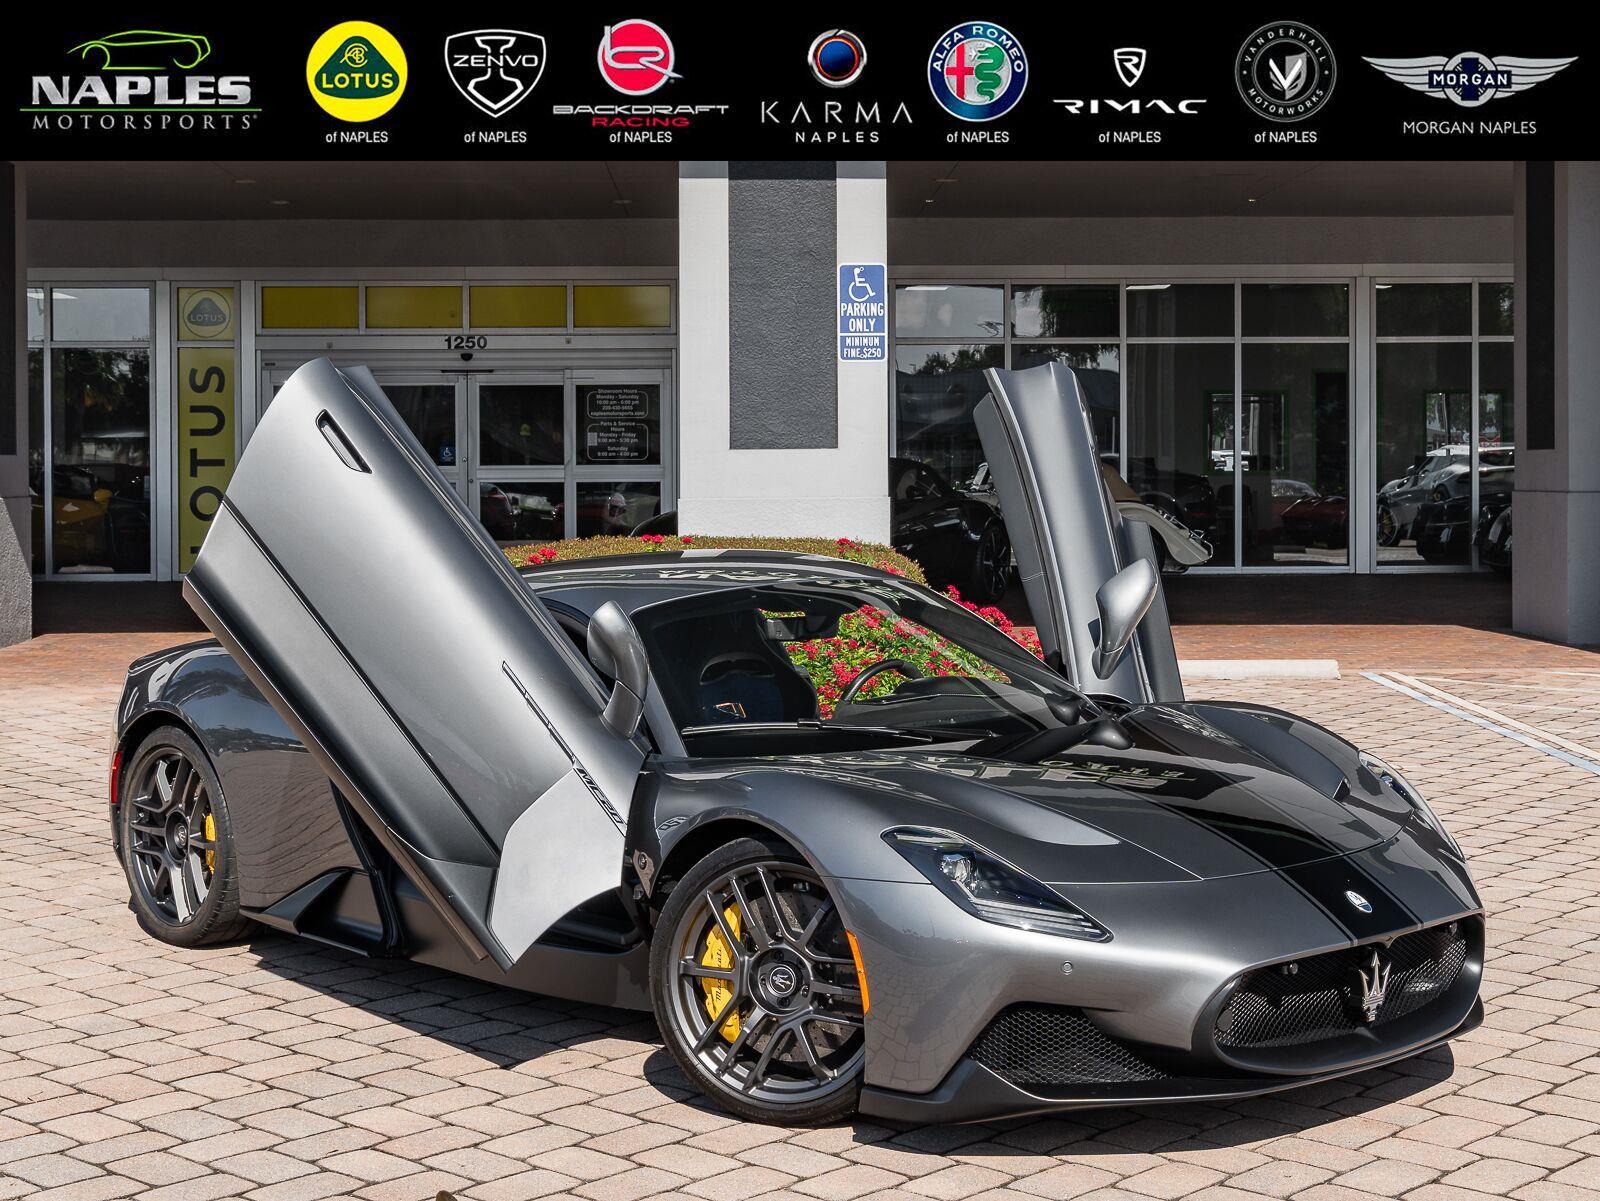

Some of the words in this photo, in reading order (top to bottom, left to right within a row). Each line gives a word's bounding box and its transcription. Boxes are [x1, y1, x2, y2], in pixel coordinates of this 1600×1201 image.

[840, 302, 884, 316] PARKING
[190, 313, 225, 322] LOTUS
[848, 318, 876, 332] ONLY
[444, 335, 488, 349] 1250
[845, 336, 880, 347] MINIMUM
[843, 348, 861, 358] FINE
[189, 365, 226, 555] OTUS
